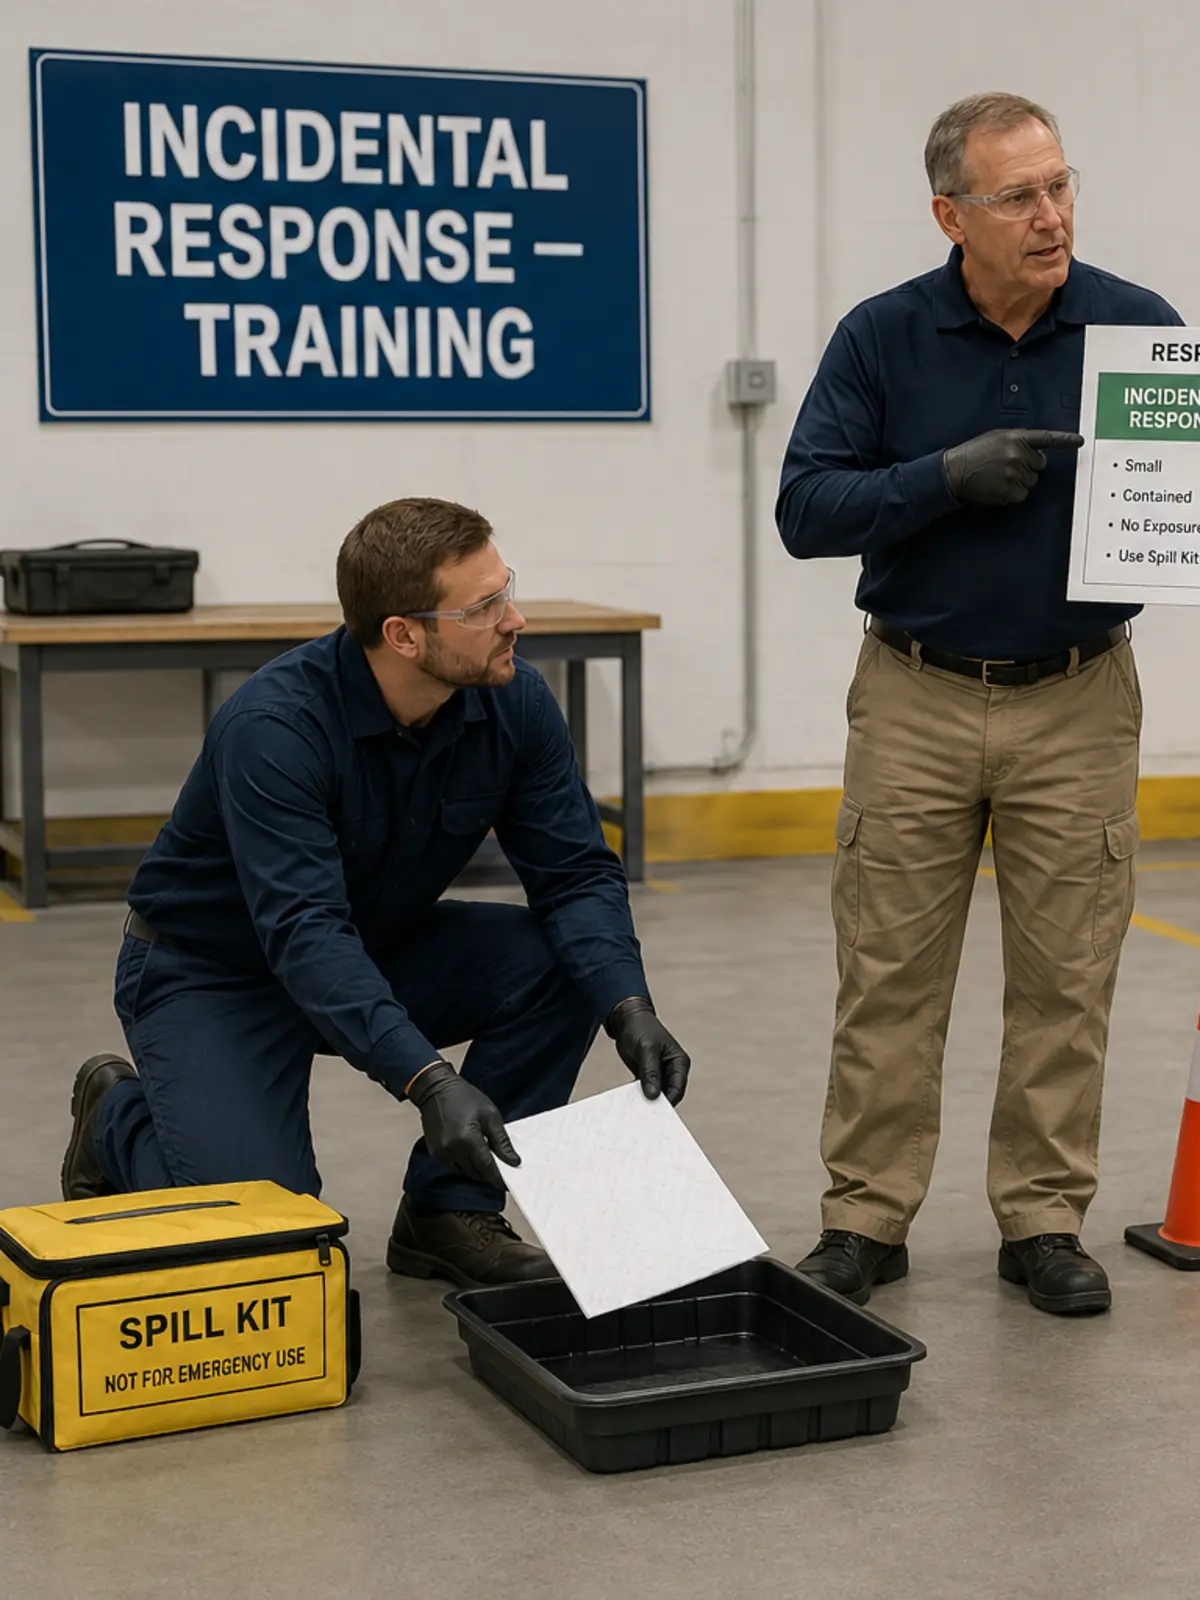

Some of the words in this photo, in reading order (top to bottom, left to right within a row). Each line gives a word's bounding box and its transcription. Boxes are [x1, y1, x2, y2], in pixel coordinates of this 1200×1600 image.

[123, 101, 569, 190] INCIDENTAL
[114, 200, 515, 283] RESPONSE
[533, 242, 584, 257] —
[183, 303, 535, 380] TRAINING
[1125, 459, 1162, 473] Small
[1123, 489, 1192, 504] Contained
[1121, 519, 1140, 533] No
[1118, 550, 1144, 563] Use
[1148, 551, 1177, 566] Spill
[1181, 552, 1200, 565] Kit
[119, 1306, 225, 1350] SPILL
[237, 1295, 292, 1334] KIT
[105, 1372, 138, 1394] NOT
[142, 1366, 175, 1388] FOR
[178, 1352, 272, 1383] EMERGENCY
[277, 1347, 306, 1368] USE
